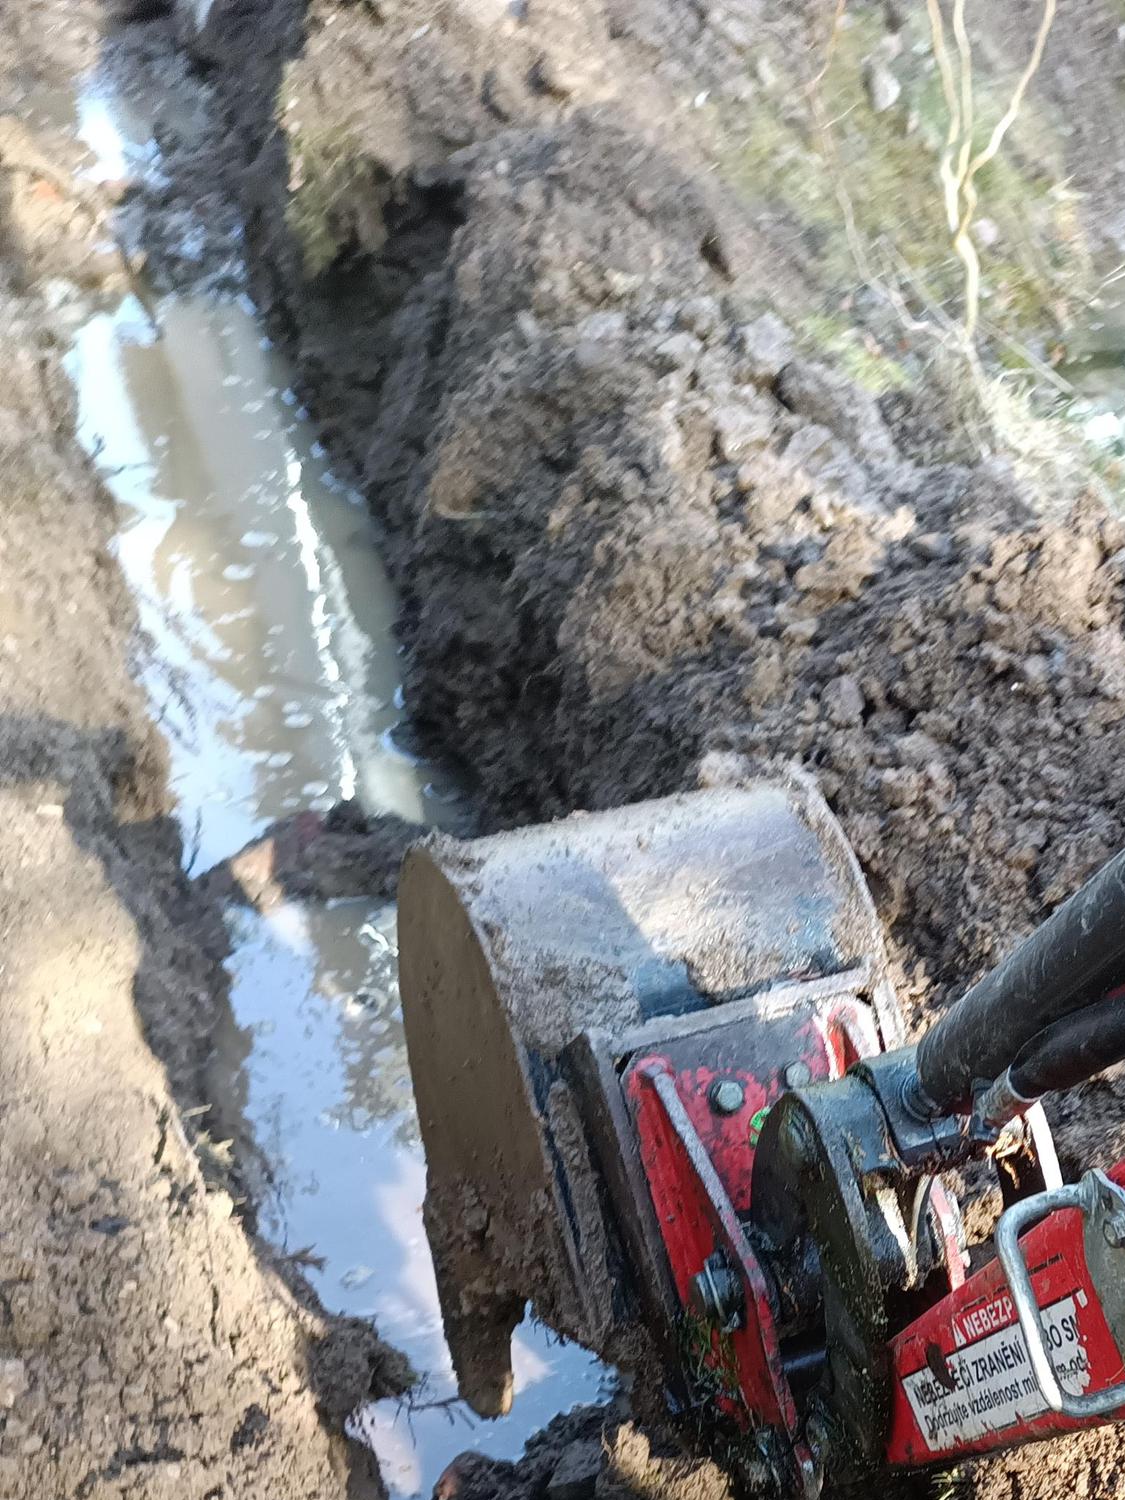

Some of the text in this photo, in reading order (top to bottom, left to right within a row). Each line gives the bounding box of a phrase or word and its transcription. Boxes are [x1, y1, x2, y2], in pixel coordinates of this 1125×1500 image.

[962, 1296, 1013, 1341] NEBEZP
[914, 1359, 976, 1408] NEBEZEČÍ
[971, 1335, 1026, 1382] ZRANĚNÍ
[925, 1402, 969, 1432] Dodržujte
[968, 1379, 1023, 1416] vzdálenost
